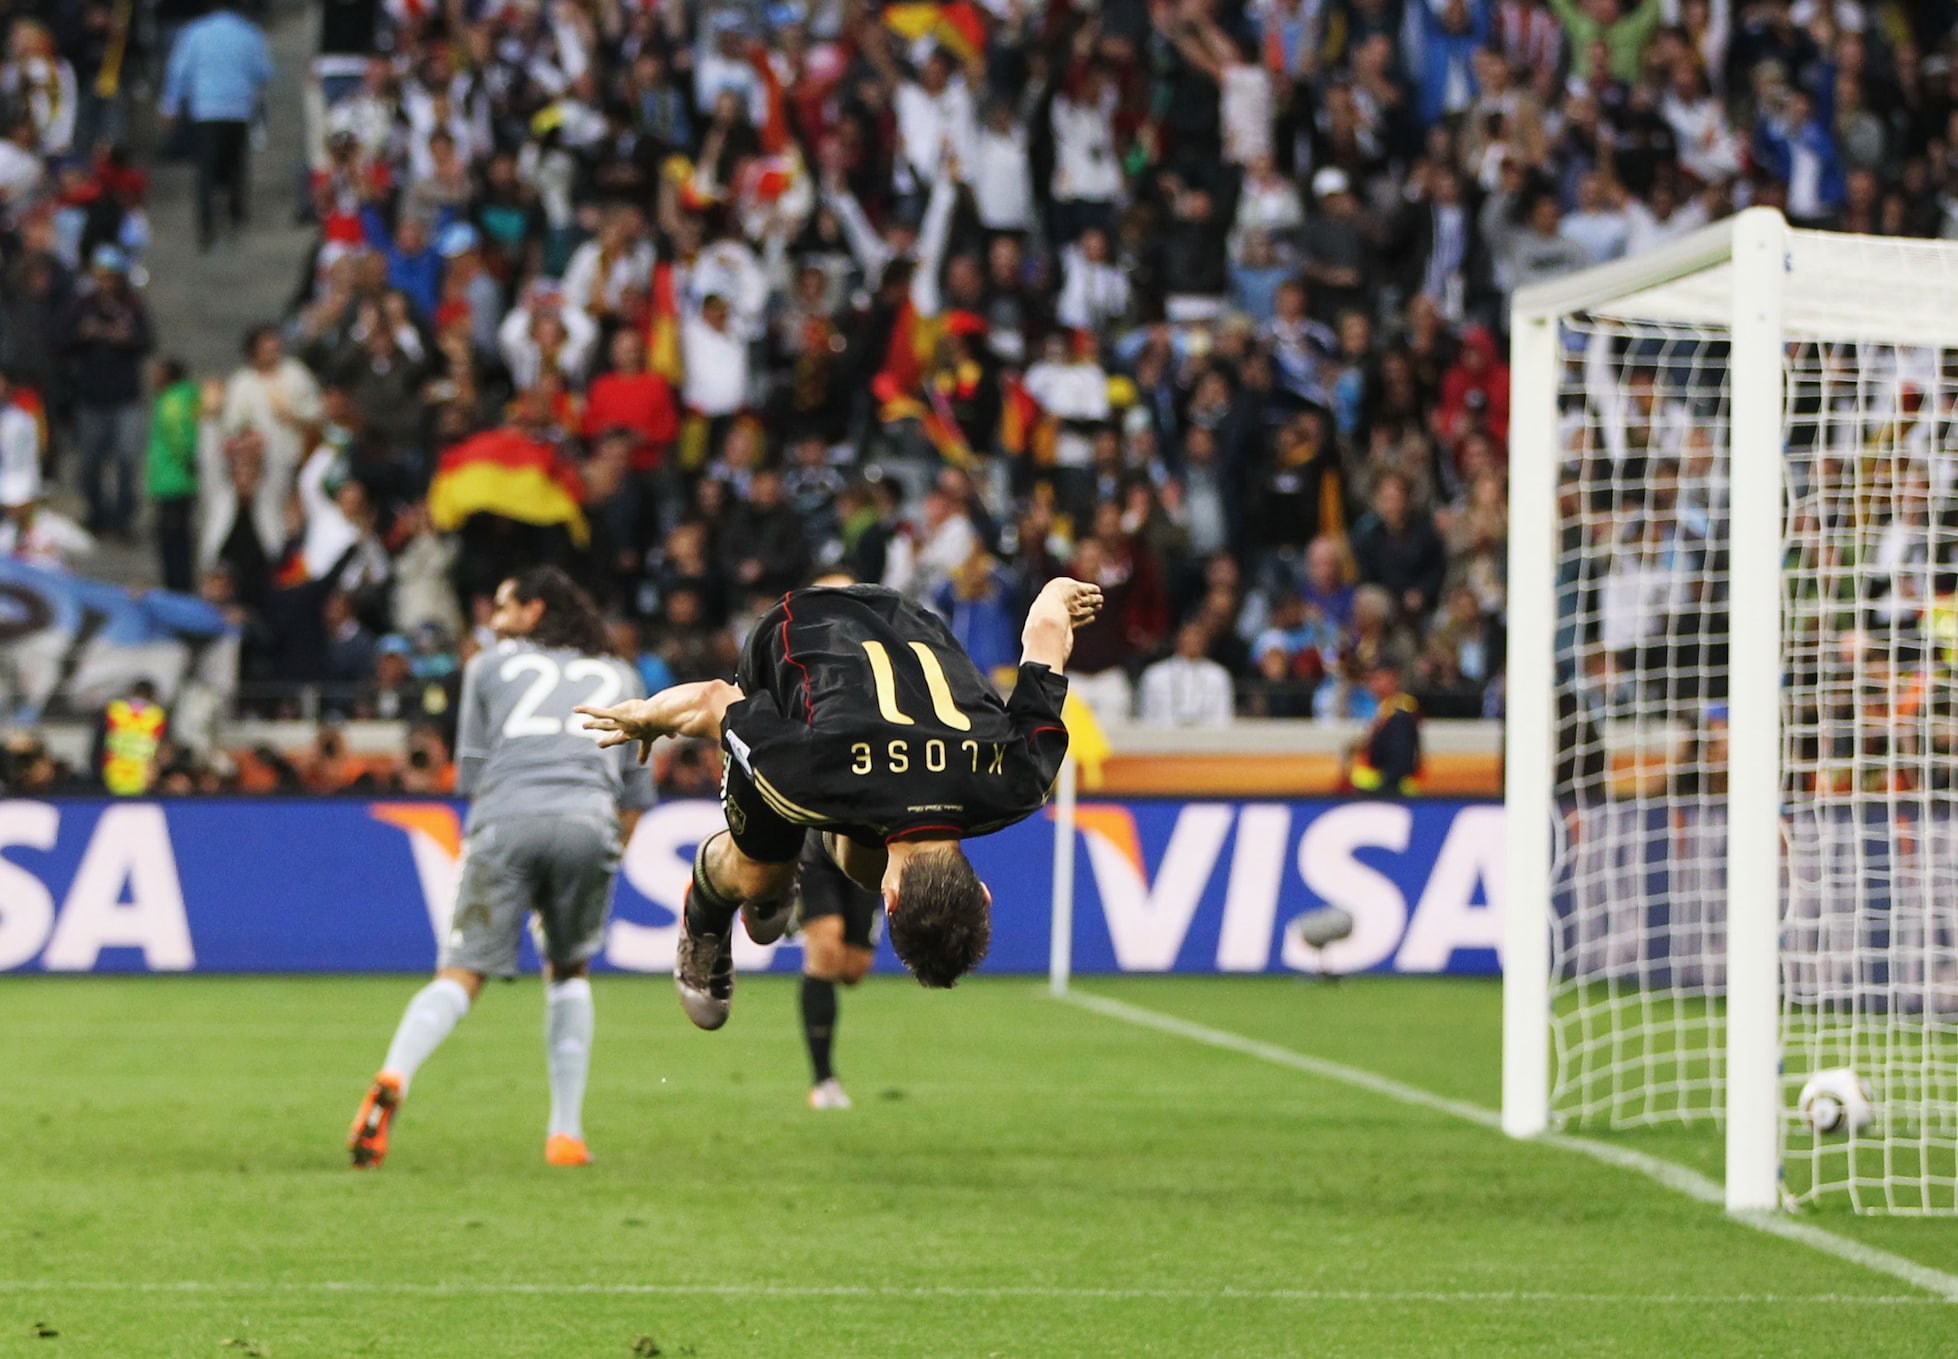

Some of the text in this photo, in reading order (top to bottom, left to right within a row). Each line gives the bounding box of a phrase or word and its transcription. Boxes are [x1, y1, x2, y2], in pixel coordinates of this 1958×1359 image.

[501, 653, 623, 742] 22
[861, 640, 972, 731] 11
[851, 739, 1007, 775] KLOSE
[1048, 802, 1506, 973] VISA
